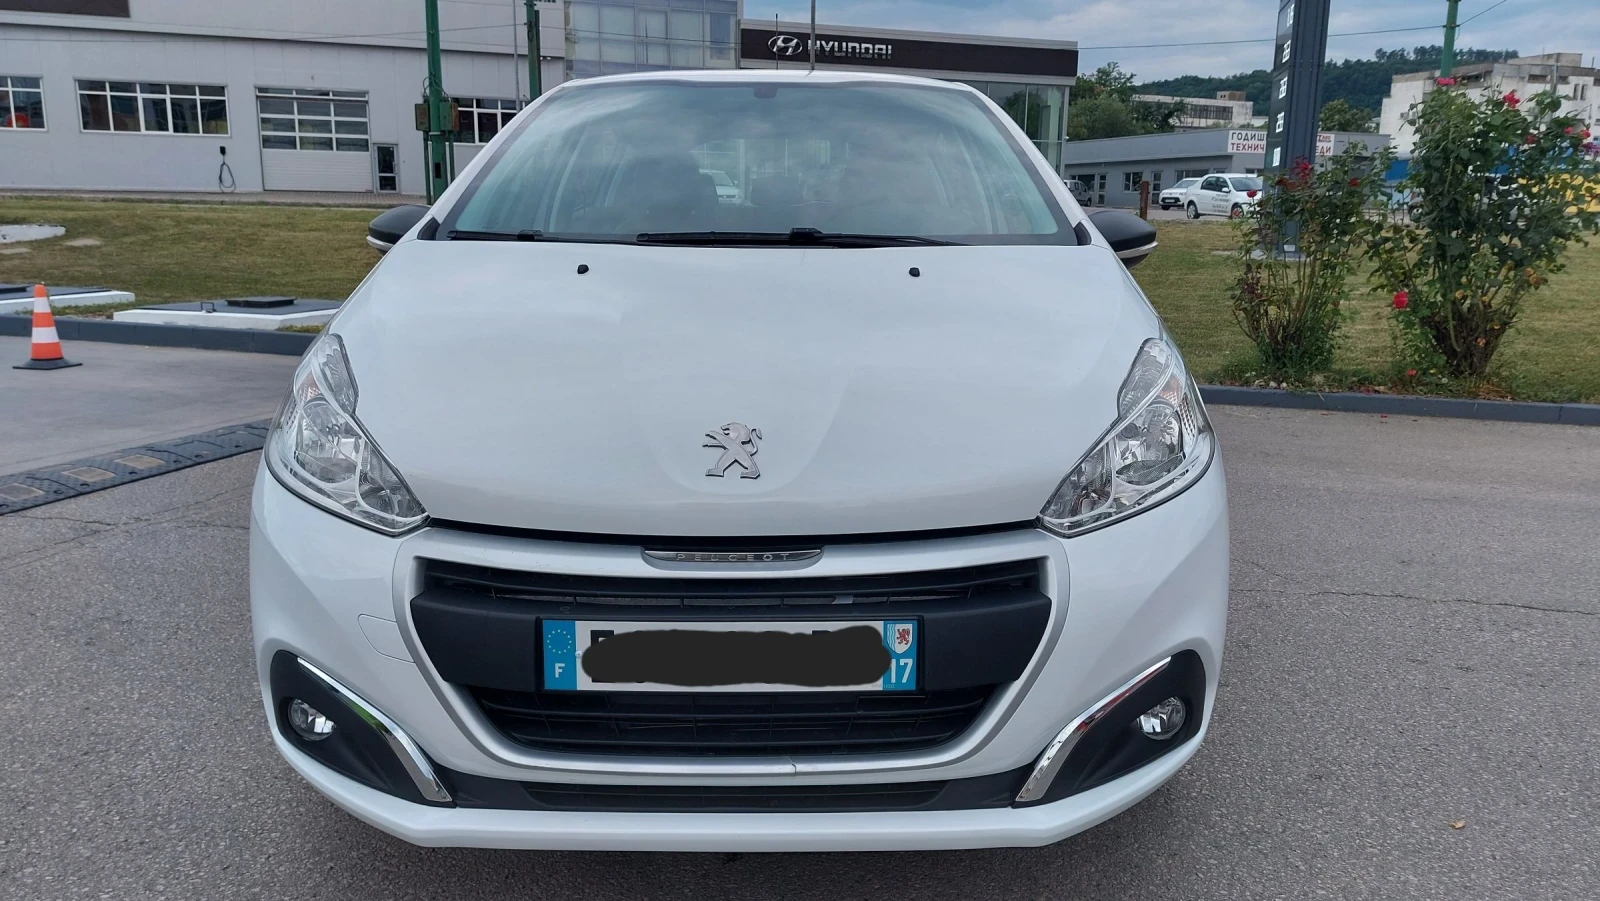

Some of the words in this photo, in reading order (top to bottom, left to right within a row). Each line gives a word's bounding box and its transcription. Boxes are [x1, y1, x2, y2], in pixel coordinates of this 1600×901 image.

[808, 39, 892, 59] HYUNDAI
[676, 553, 789, 561] PEUGEOT
[555, 663, 565, 678] F
[890, 658, 913, 683] 17
